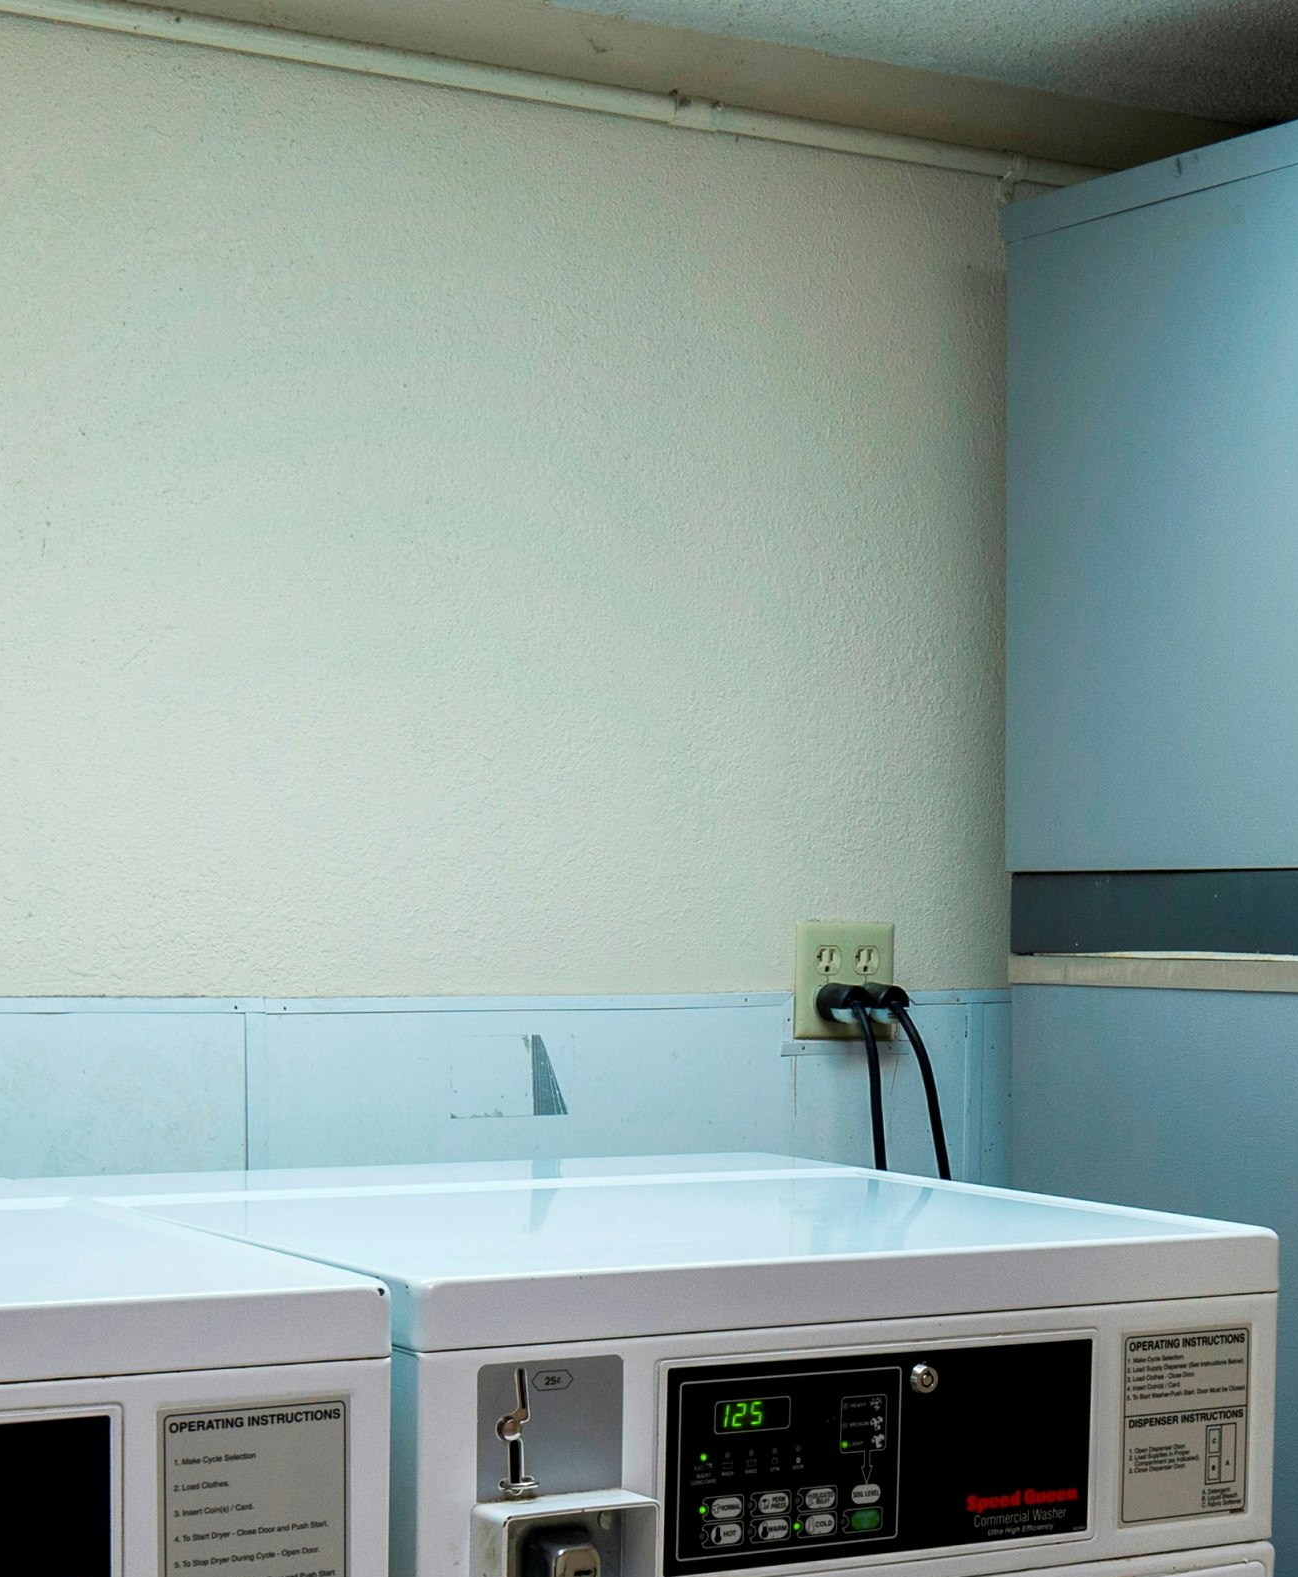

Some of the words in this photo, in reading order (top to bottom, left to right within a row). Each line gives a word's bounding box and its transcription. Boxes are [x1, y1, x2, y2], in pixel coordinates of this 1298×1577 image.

[1129, 1339, 1180, 1352] OPERATING
[1182, 1333, 1245, 1347] INSTRUCTIONS
[1147, 1356, 1161, 1364] Cycle
[1146, 1364, 1163, 1373] Supply
[1164, 1362, 1187, 1371] Dispenser
[1146, 1373, 1164, 1381] Clothes
[723, 1401, 762, 1428] 125
[1129, 1416, 1179, 1429] DISPENSER
[1181, 1409, 1244, 1423] INSTRUCTIONS
[169, 1417, 244, 1434] OPERATING
[248, 1408, 341, 1427] INSTRUCTIONS
[1149, 1445, 1172, 1453] Dispenser
[174, 1458, 181, 1466] 1.
[182, 1456, 201, 1466] Make
[202, 1454, 222, 1466] Cycle
[224, 1451, 256, 1462] Selection
[1149, 1464, 1172, 1473] Dispenser
[173, 1484, 181, 1492] 2.
[182, 1482, 200, 1491] Load
[865, 1489, 880, 1497] LEVEL
[966, 1490, 1021, 1513] Speed
[1024, 1488, 1078, 1505] Queen
[174, 1510, 181, 1518] 3.
[182, 1507, 202, 1517] Insert
[203, 1504, 230, 1516] Coin(s)
[236, 1502, 254, 1511] Card.
[720, 1503, 740, 1512] NORMAL
[974, 1511, 1029, 1527] Commercial
[1033, 1508, 1067, 1521] Washer
[768, 1524, 788, 1532] WARM
[815, 1520, 833, 1528] COLD
[174, 1535, 181, 1543] 4.
[182, 1533, 191, 1542] To
[192, 1531, 209, 1541] Start
[211, 1529, 231, 1541] Dryer
[237, 1527, 257, 1537] Close
[258, 1524, 276, 1534] Door
[277, 1522, 290, 1532] and
[291, 1520, 309, 1530] Push
[310, 1518, 329, 1528] Start.
[723, 1529, 737, 1537] HOT
[1005, 1527, 1020, 1536] High
[1022, 1524, 1054, 1533] Efficiency
[174, 1561, 181, 1569] 5.
[182, 1559, 191, 1568] To
[192, 1557, 209, 1569] Stop
[211, 1555, 230, 1567] Dryer
[231, 1552, 255, 1564] During
[256, 1549, 276, 1562] Cycle
[281, 1548, 301, 1559] Open
[302, 1546, 320, 1556] Door.
